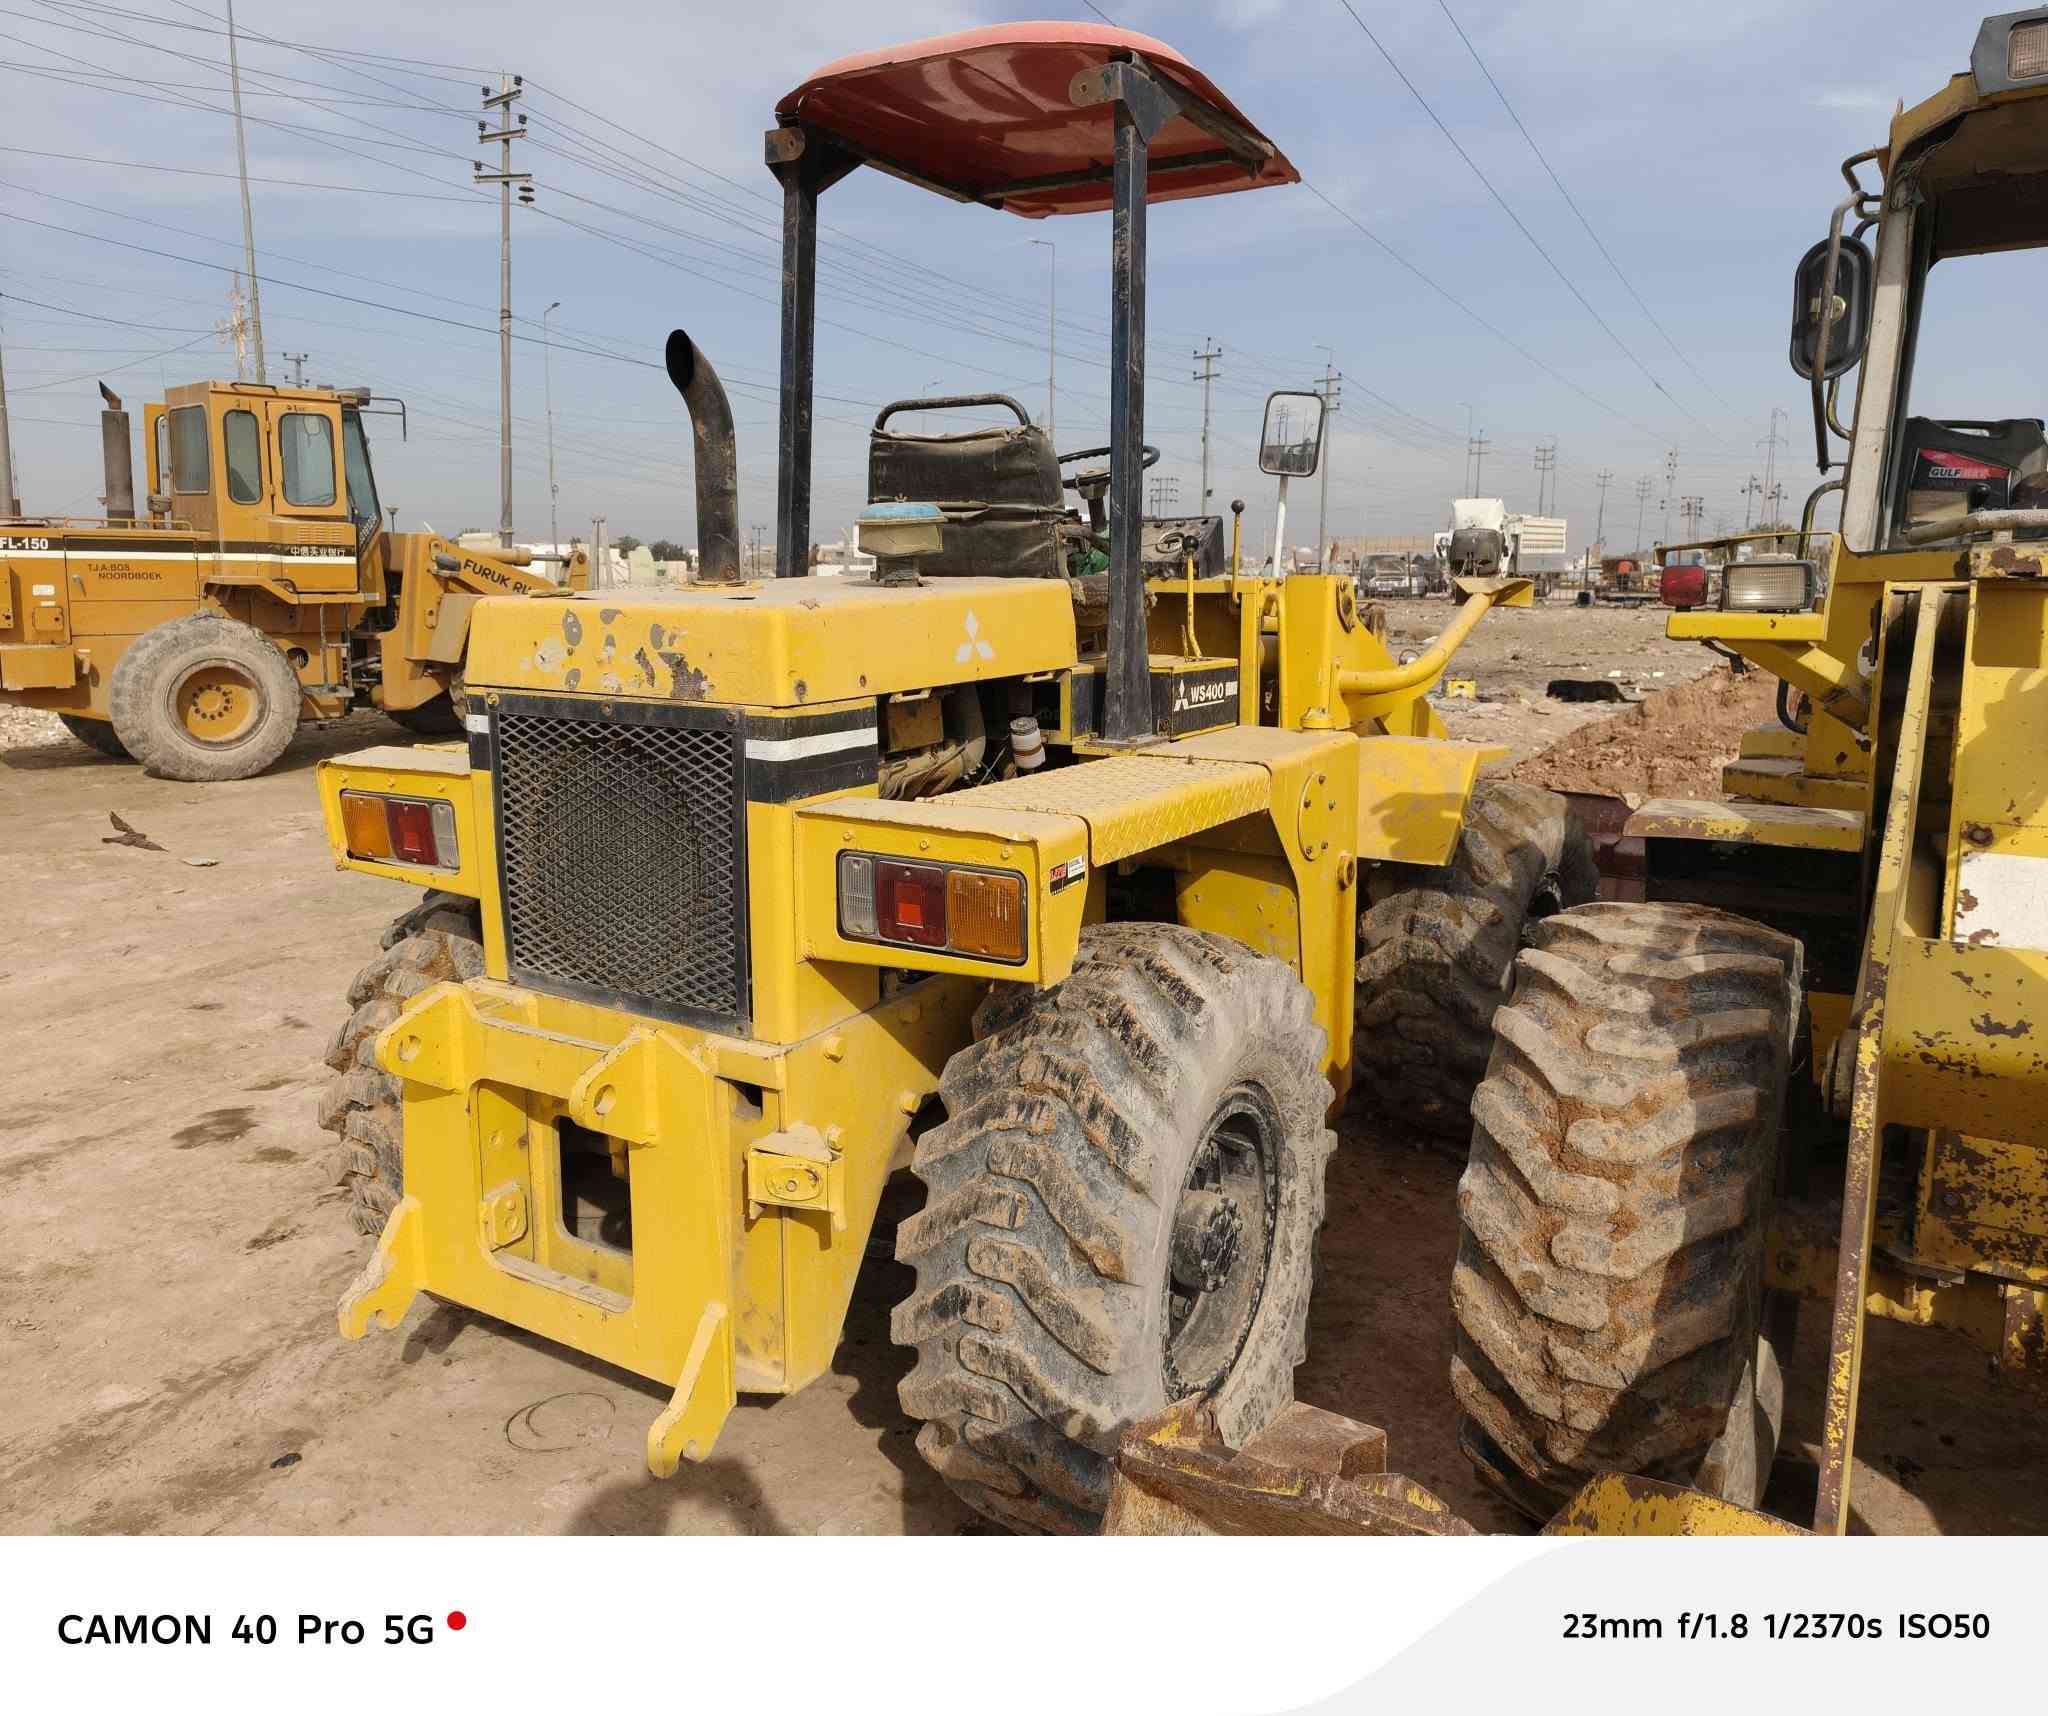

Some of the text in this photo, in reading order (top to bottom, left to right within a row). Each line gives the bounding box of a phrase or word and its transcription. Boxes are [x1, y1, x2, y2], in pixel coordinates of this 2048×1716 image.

[1930, 467, 1961, 479] GULF
[0, 537, 49, 550] FL-150
[463, 558, 511, 588] FURUK
[1190, 682, 1224, 703] WS400
